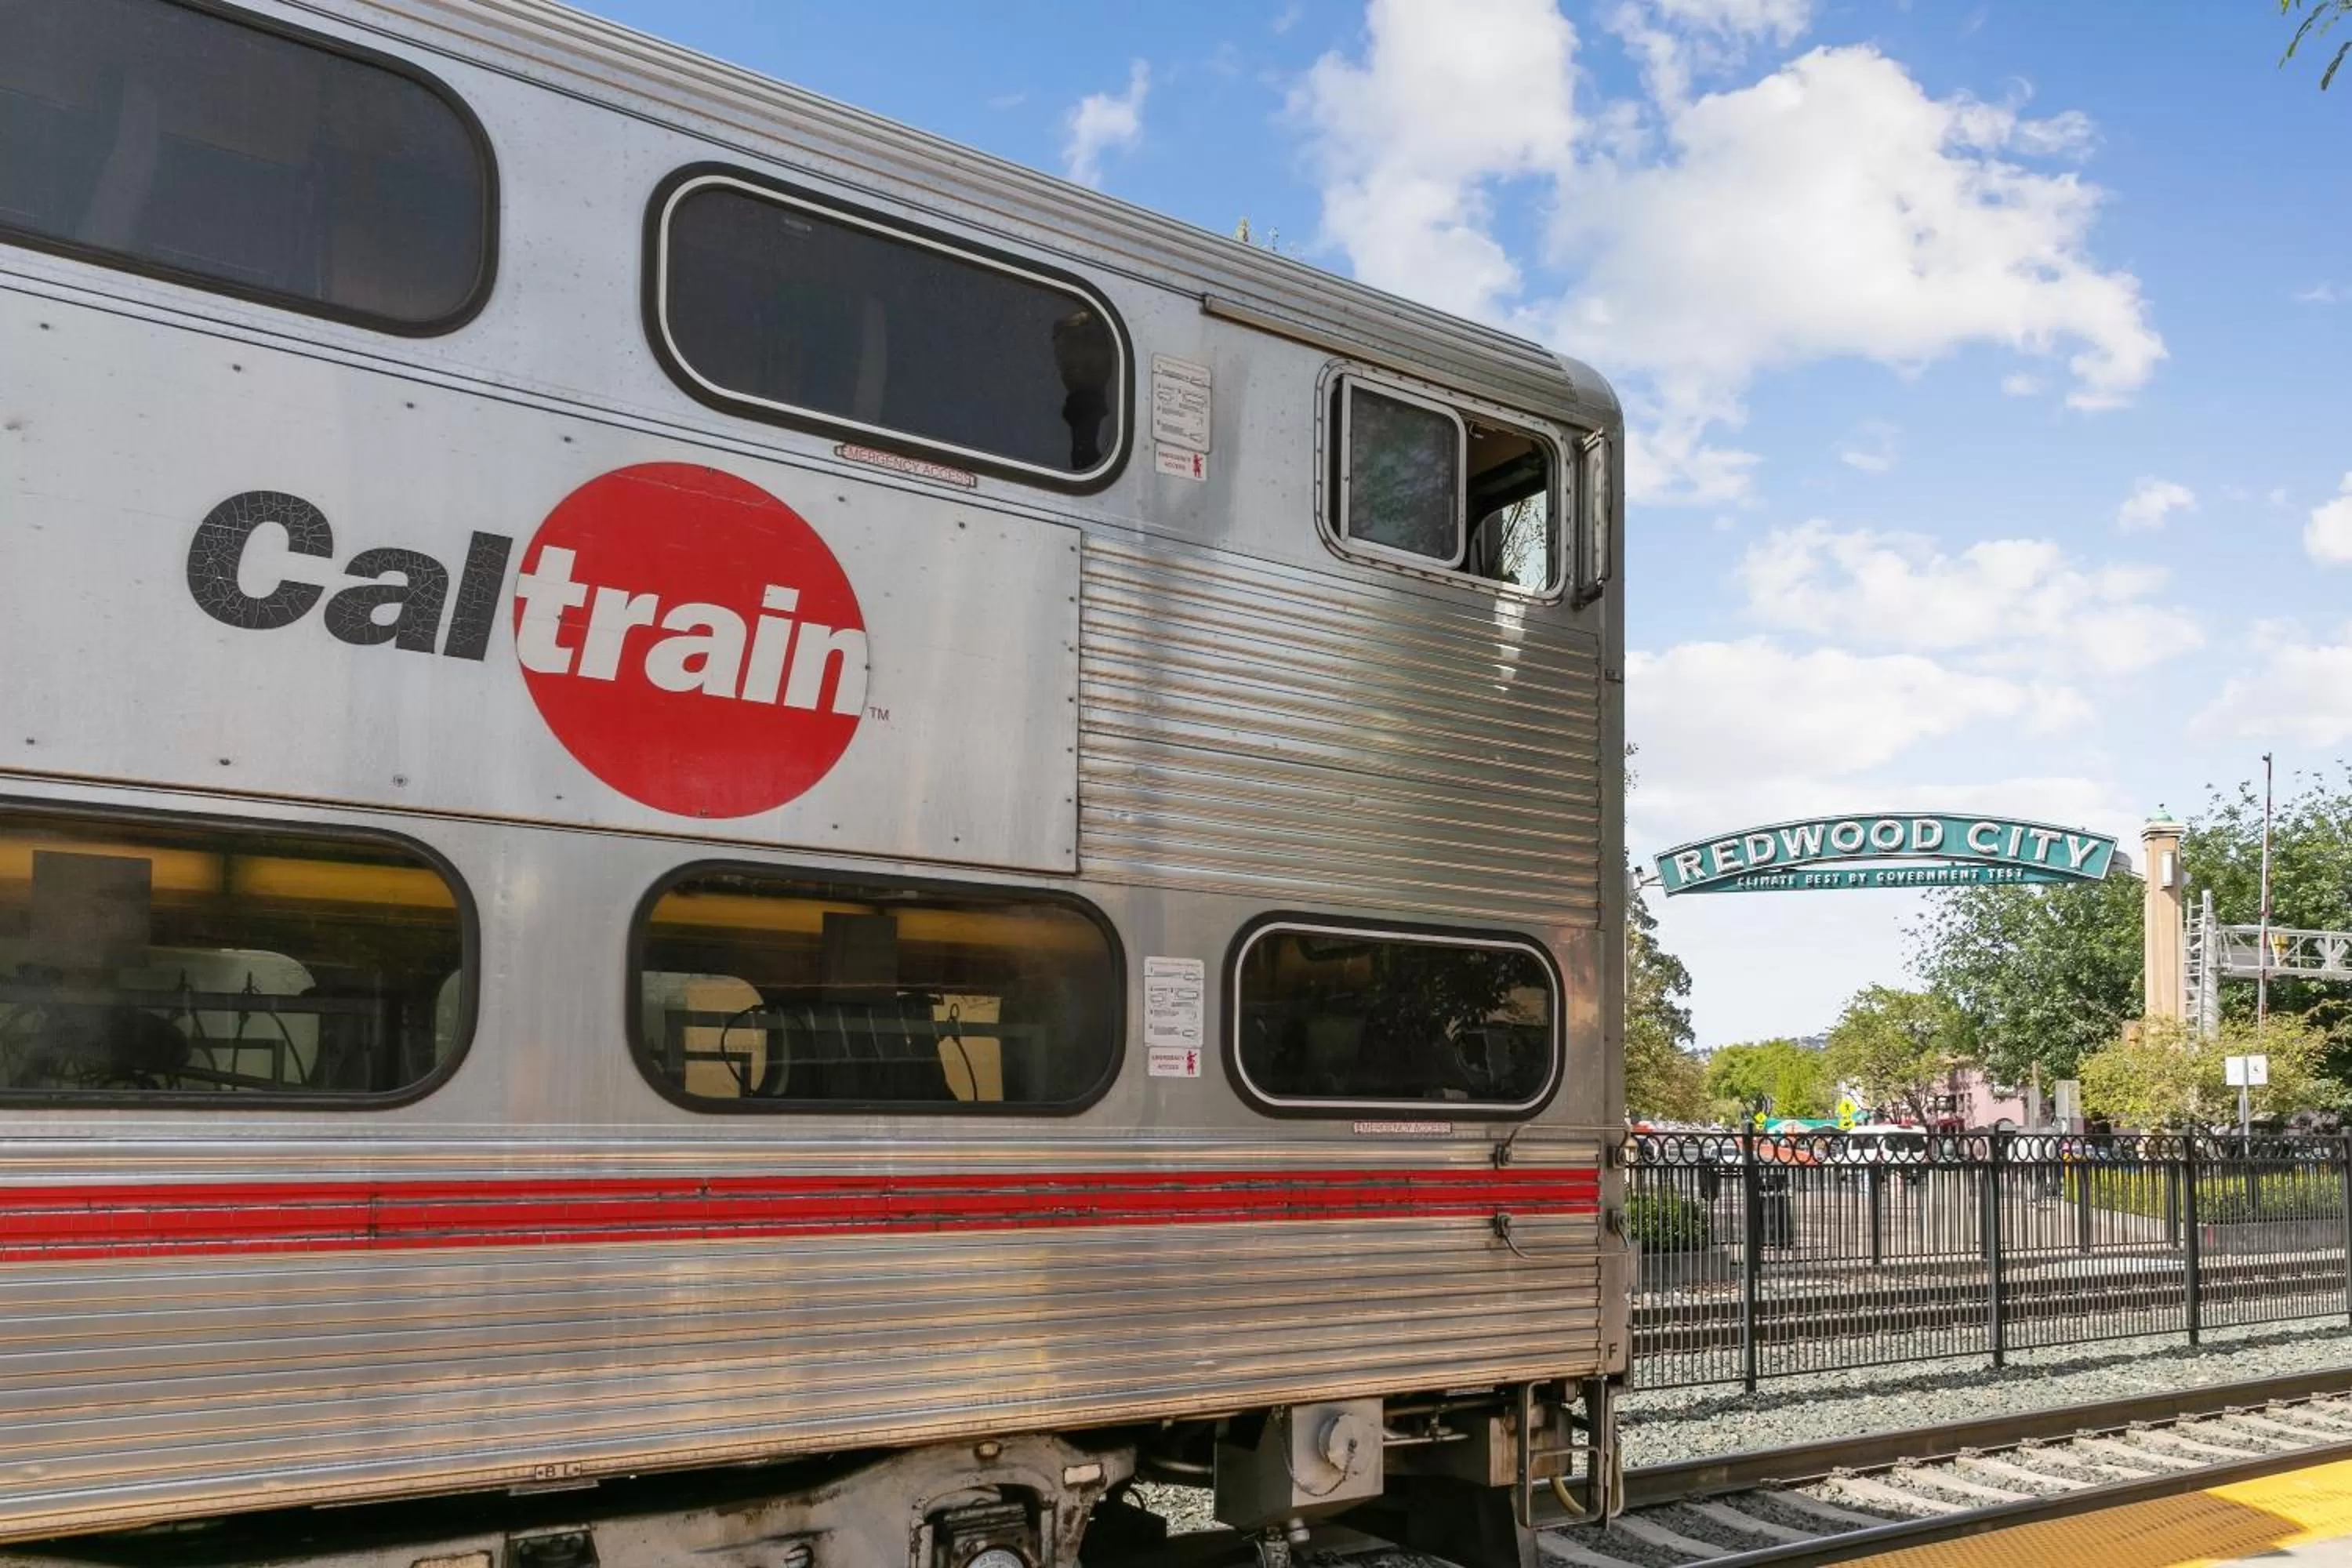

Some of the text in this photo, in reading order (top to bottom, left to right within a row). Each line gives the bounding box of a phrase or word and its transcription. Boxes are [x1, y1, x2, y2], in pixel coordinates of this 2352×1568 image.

[842, 445, 920, 471] EMERGENCY
[186, 489, 869, 717] Caltrain
[868, 706, 890, 721] TM
[1675, 818, 2100, 884] REDWOOD CITY
[1737, 867, 2024, 887] CLIMATE BEST BY GOVERNMENT TEST
[1608, 1342, 1618, 1359] F
